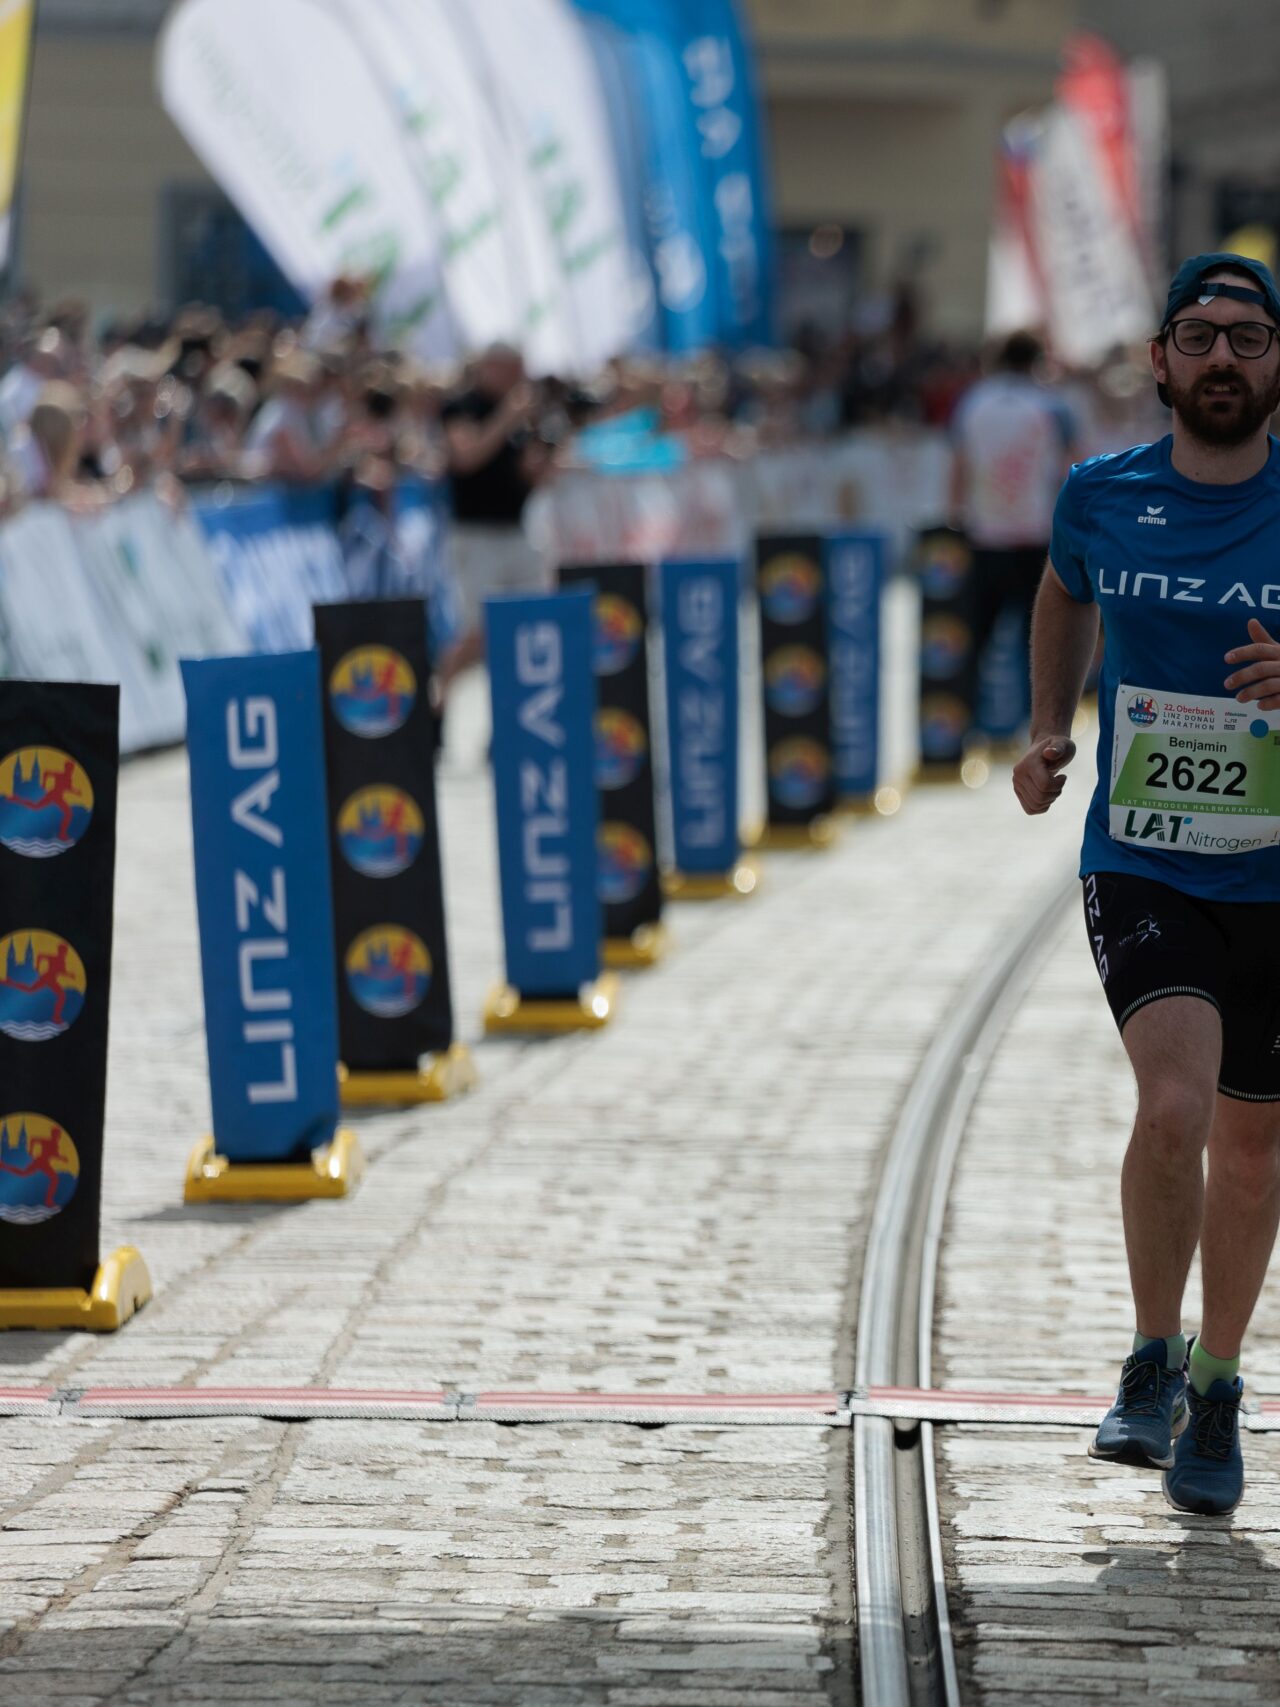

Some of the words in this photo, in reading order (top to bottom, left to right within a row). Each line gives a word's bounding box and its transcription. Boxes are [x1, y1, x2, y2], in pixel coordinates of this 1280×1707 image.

[1137, 514, 1167, 525] erima
[1099, 568, 1206, 602] LINZ
[514, 619, 567, 748] AG
[1162, 711, 1181, 720] LINZ
[1184, 714, 1215, 724] DONAU
[1162, 719, 1215, 731] MARATHON
[1176, 704, 1215, 716] Oberbank
[1168, 736, 1228, 753] Benjamin
[226, 695, 284, 849] AG
[1145, 752, 1248, 797] 2622
[1124, 809, 1184, 843] LAT
[1186, 831, 1262, 852] Nitrogen
[520, 757, 573, 952] LINZ
[234, 867, 299, 1105] LINZ
